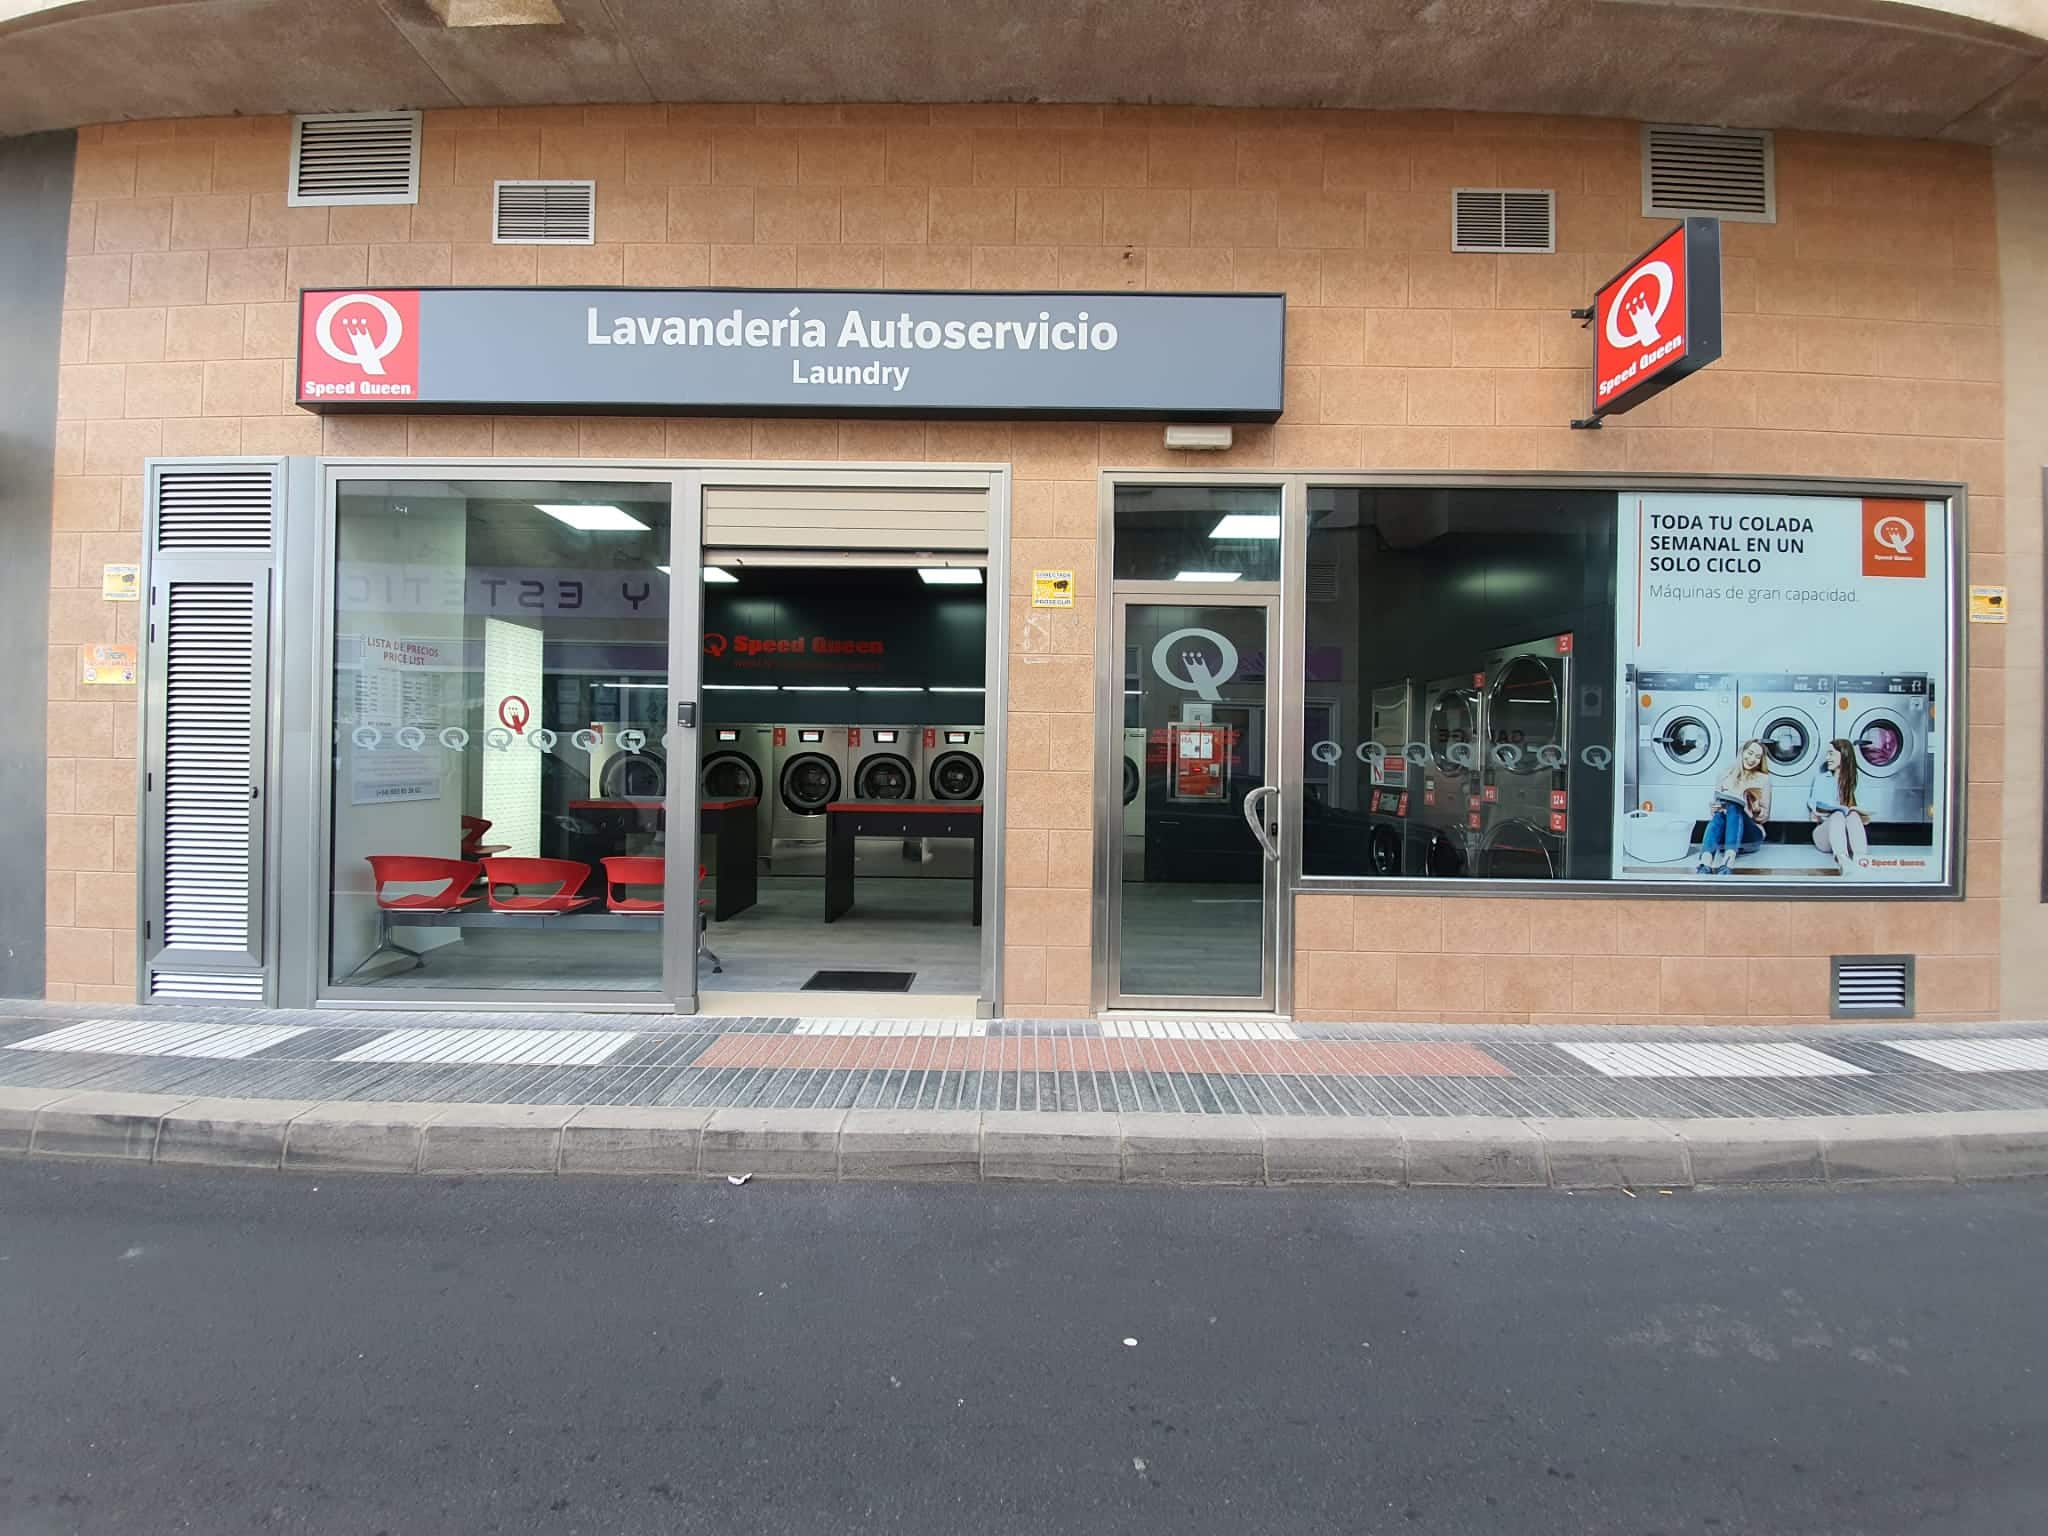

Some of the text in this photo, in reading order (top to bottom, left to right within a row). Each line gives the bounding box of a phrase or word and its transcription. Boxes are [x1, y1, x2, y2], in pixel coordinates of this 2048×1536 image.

[587, 306, 1120, 352] Lavandería Autoservicio
[792, 359, 910, 391] Laundry
[1599, 334, 1682, 396] Speed Queen
[305, 381, 412, 397] Speed Queen
[1650, 514, 1814, 533] TODA TU COLADA
[1650, 535, 1804, 554] SEMANAL EN UN
[1650, 556, 1761, 574] SOLO CICLO
[1650, 583, 1721, 601] Máquinas
[1725, 585, 1744, 600] de
[1749, 587, 1781, 604] gran
[367, 637, 392, 650] LISTA
[406, 643, 439, 658] PRECIOS
[733, 635, 805, 657] Speed
[383, 651, 425, 666] PRICE LIST
